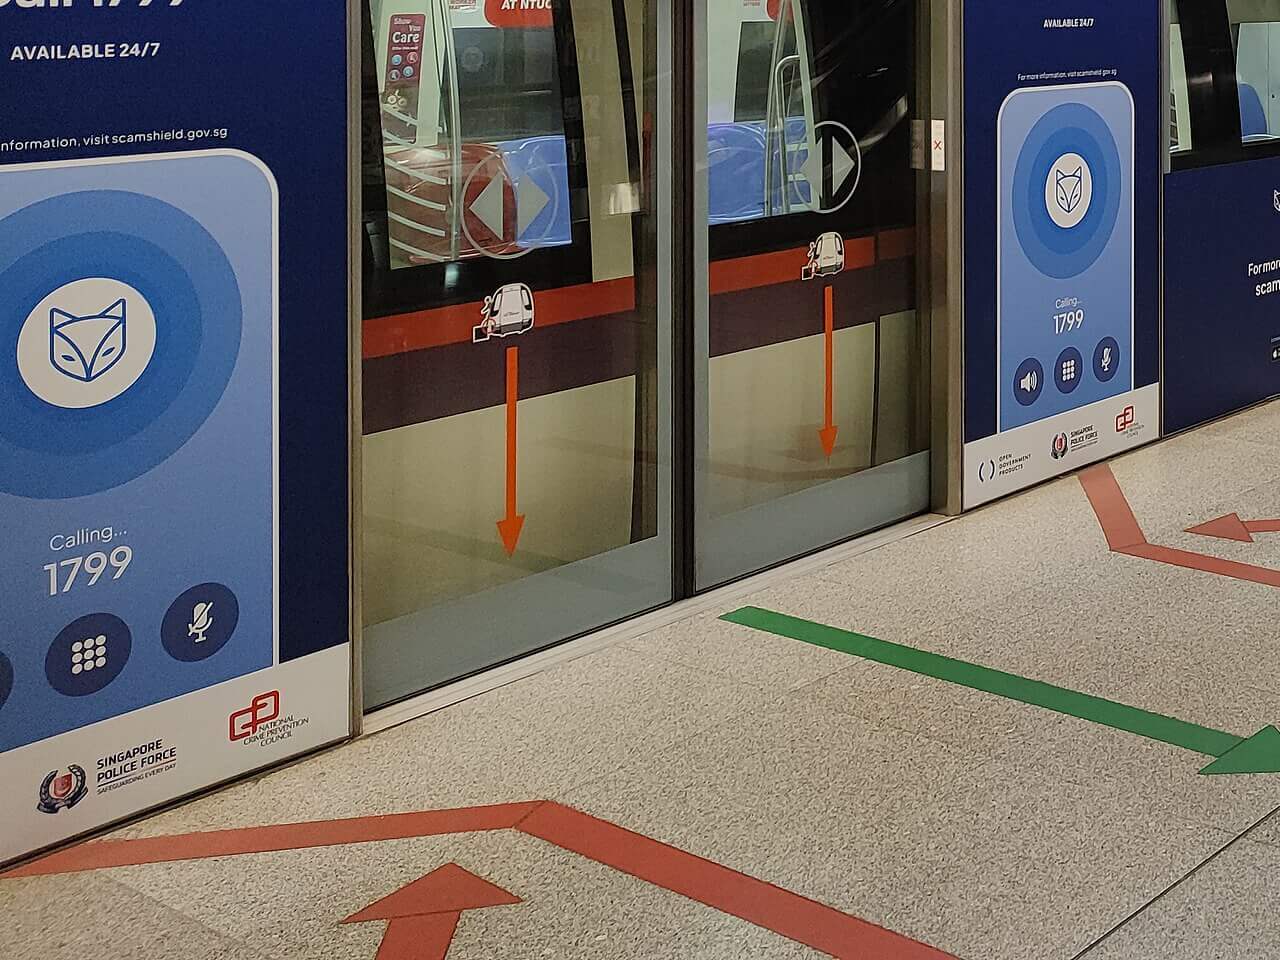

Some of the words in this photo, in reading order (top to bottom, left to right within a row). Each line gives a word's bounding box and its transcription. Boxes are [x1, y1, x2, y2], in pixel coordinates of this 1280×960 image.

[1043, 18, 1078, 29] AVAILABLE
[1078, 18, 1094, 28] 24/7
[392, 31, 420, 44] Care
[11, 43, 116, 61] AVAILABLE
[119, 42, 161, 58] 24/7
[0, 136, 81, 152] nformation,
[83, 133, 110, 147] visit
[112, 127, 228, 145] scamshield.gov.sg
[1248, 262, 1262, 277] For
[1053, 309, 1084, 334] 1799
[49, 525, 128, 551] Calling...
[43, 545, 133, 596] 1799
[243, 730, 265, 746] CRIME
[266, 717, 310, 739] PREVENTION
[259, 715, 295, 732] NATIONAL
[259, 731, 292, 748] COUNCIL
[96, 738, 163, 770] SINGAPORE
[97, 760, 138, 784] POLICE
[140, 746, 177, 769] FORCE
[97, 774, 145, 796] SAFEGUARDING
[144, 767, 164, 779] EVERY
[164, 763, 177, 774] DAY
